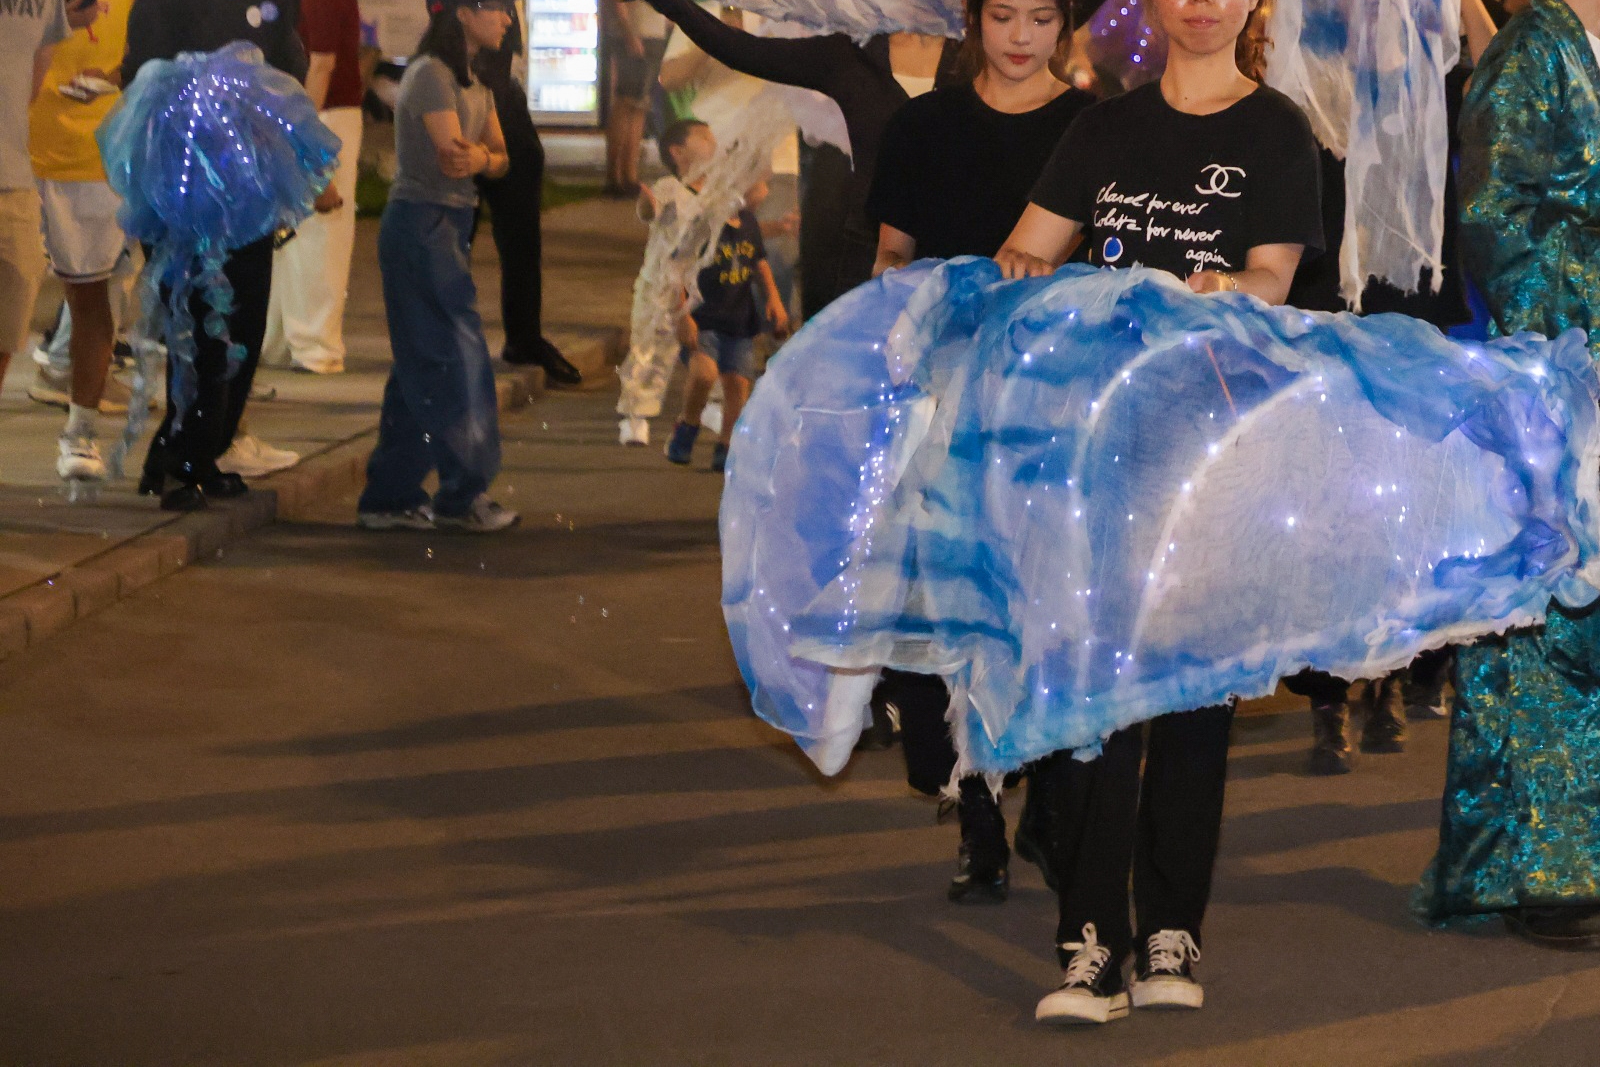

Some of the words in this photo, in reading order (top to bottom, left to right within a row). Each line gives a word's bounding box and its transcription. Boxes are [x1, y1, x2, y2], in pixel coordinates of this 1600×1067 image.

[1146, 216, 1171, 242] for
[1174, 227, 1223, 242] never
[1185, 248, 1232, 273] again
